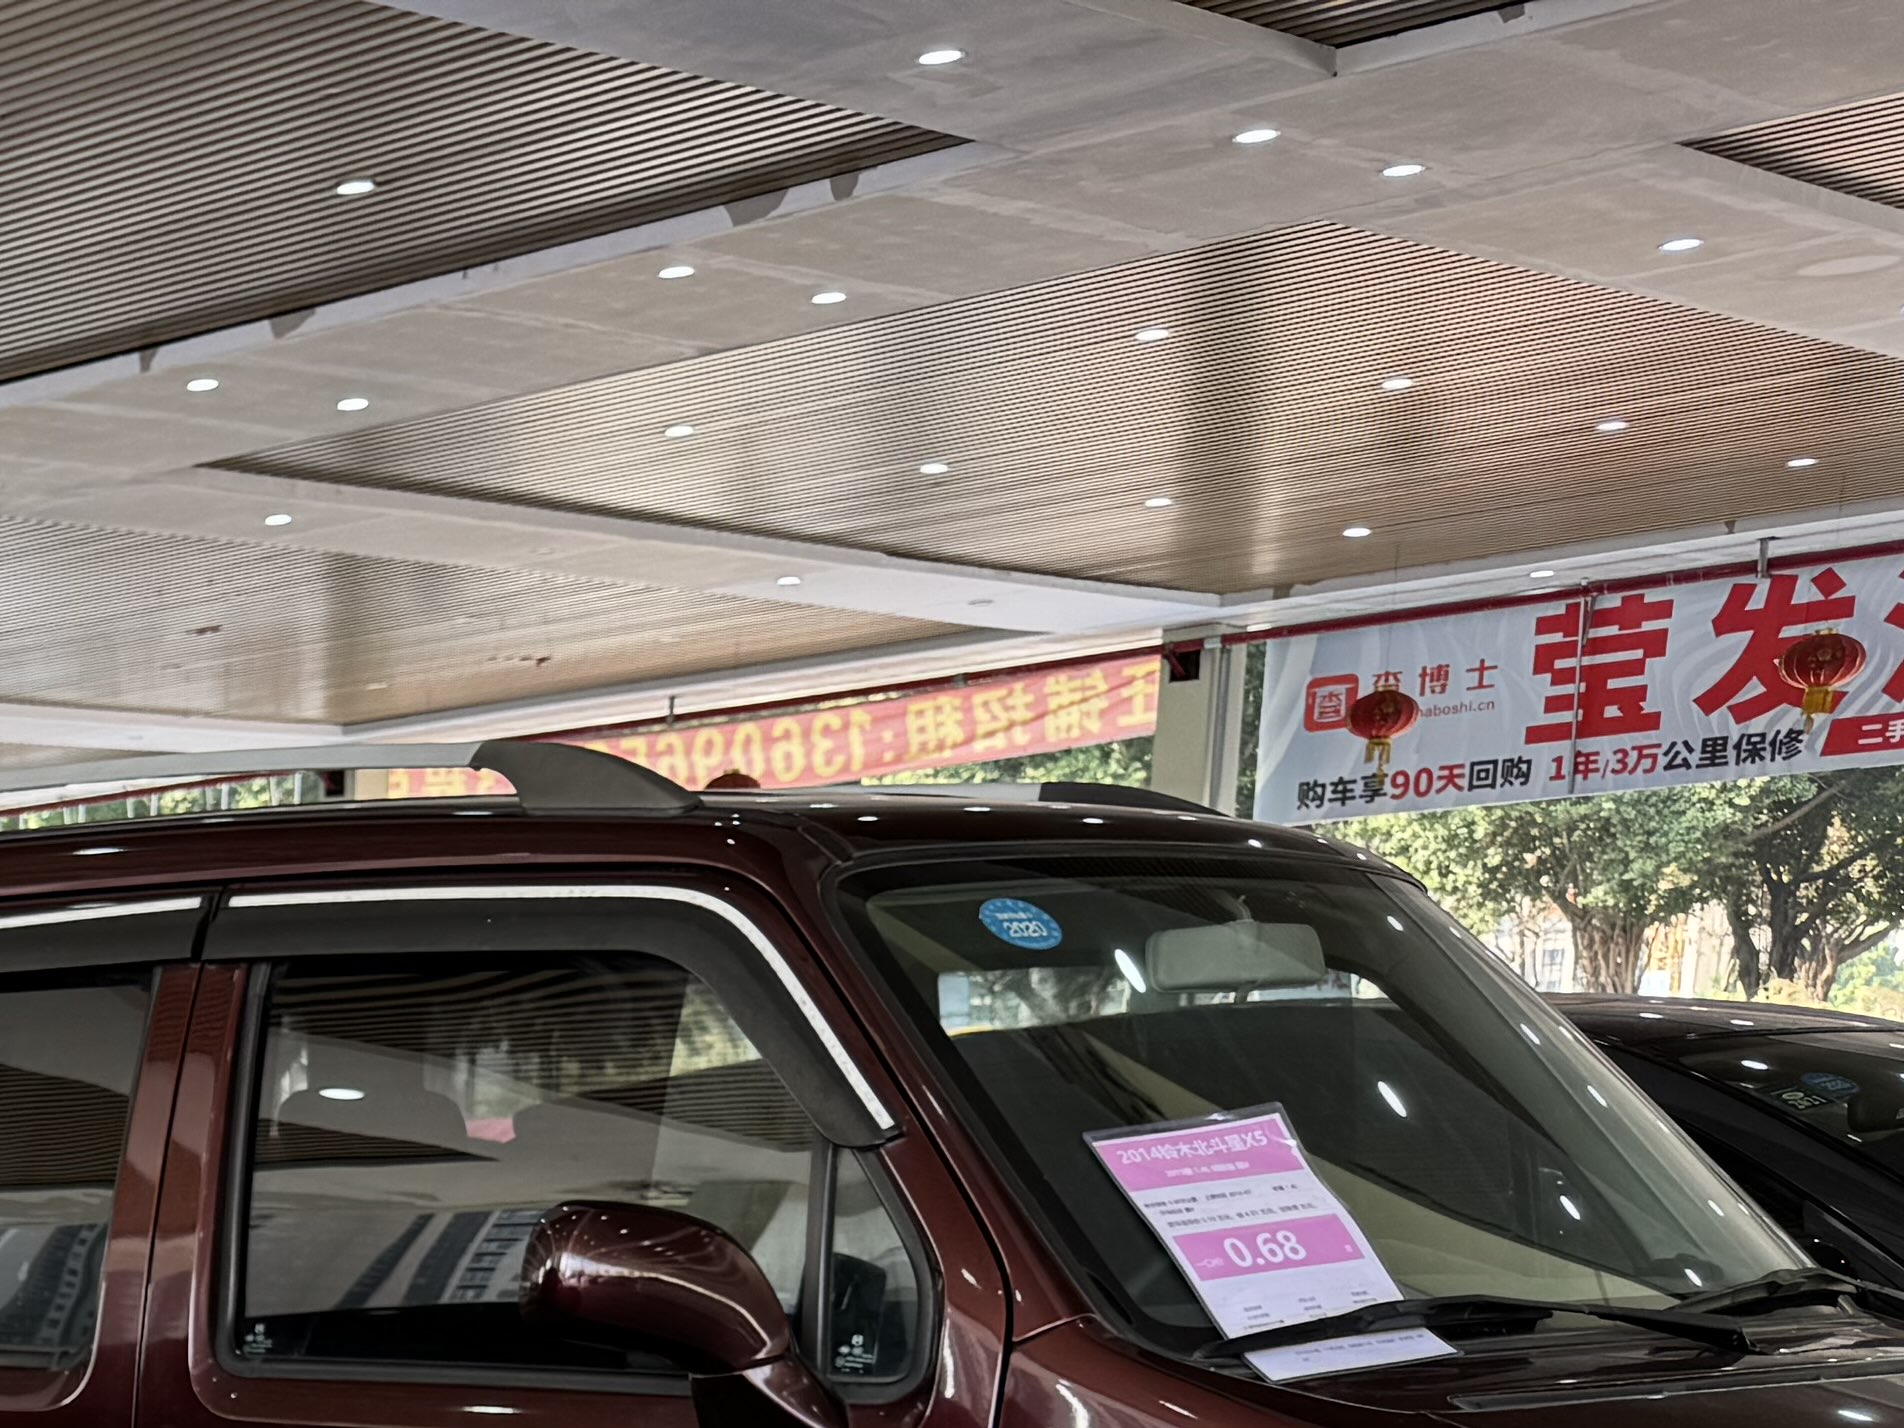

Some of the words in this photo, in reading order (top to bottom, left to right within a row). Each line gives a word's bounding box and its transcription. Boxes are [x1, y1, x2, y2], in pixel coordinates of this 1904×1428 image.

[1524, 567, 1904, 745] 莹发
[1296, 755, 1532, 811] 购车享90天回购
[1548, 727, 1805, 783] 1年/3万公里保修
[1003, 920, 1048, 938] 2020
[1223, 1230, 1307, 1269] 0.68
